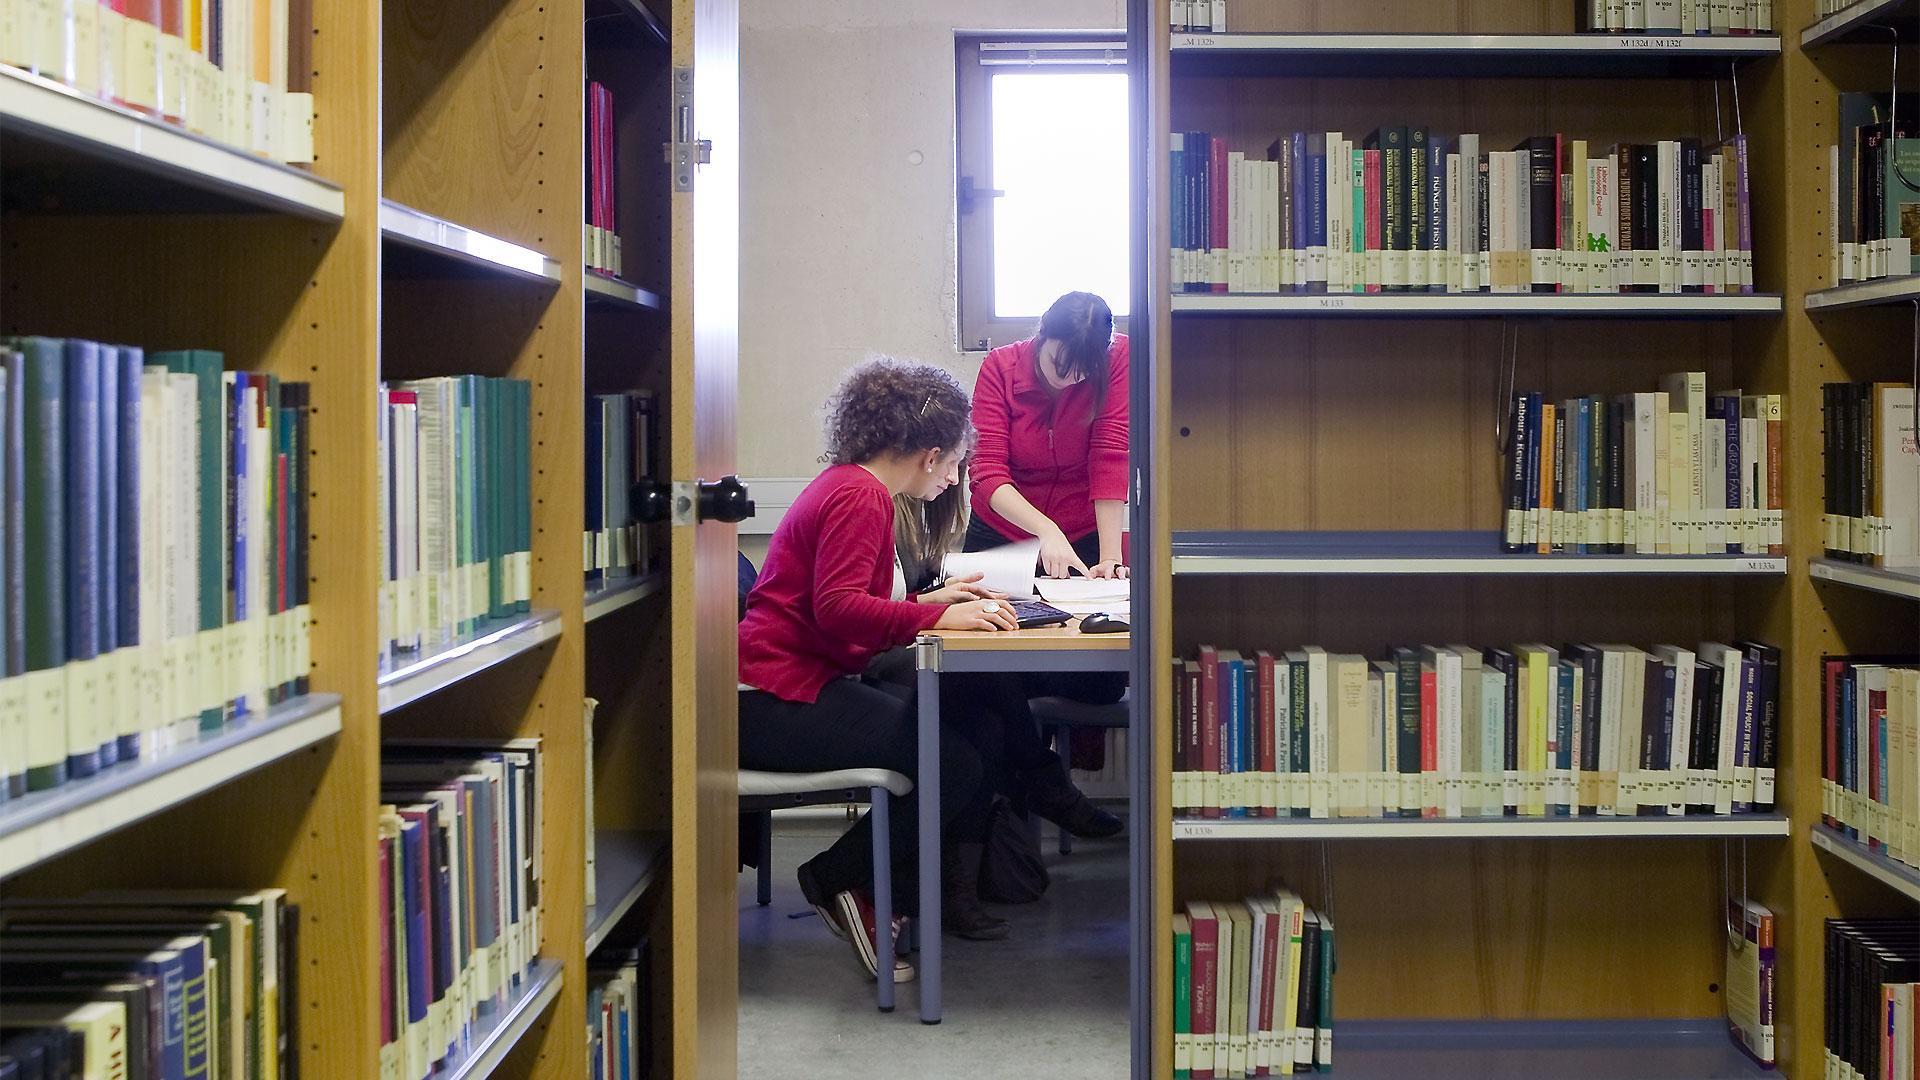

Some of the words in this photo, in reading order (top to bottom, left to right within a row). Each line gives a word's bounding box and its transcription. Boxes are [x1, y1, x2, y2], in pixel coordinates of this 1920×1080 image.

[1620, 178, 1630, 220] INDUSTRIOUS
[1434, 216, 1441, 225] IN
[1620, 222, 1630, 250] REVOLUT
[1516, 398, 1526, 440] Labour's
[1728, 421, 1738, 441] THE
[1515, 444, 1524, 480] Reward
[1728, 443, 1738, 474] GREAT
[1745, 692, 1753, 712] SOCIAL
[1762, 701, 1773, 726] Gilding
[1744, 713, 1752, 732] POLICY
[1763, 740, 1772, 762] Market
